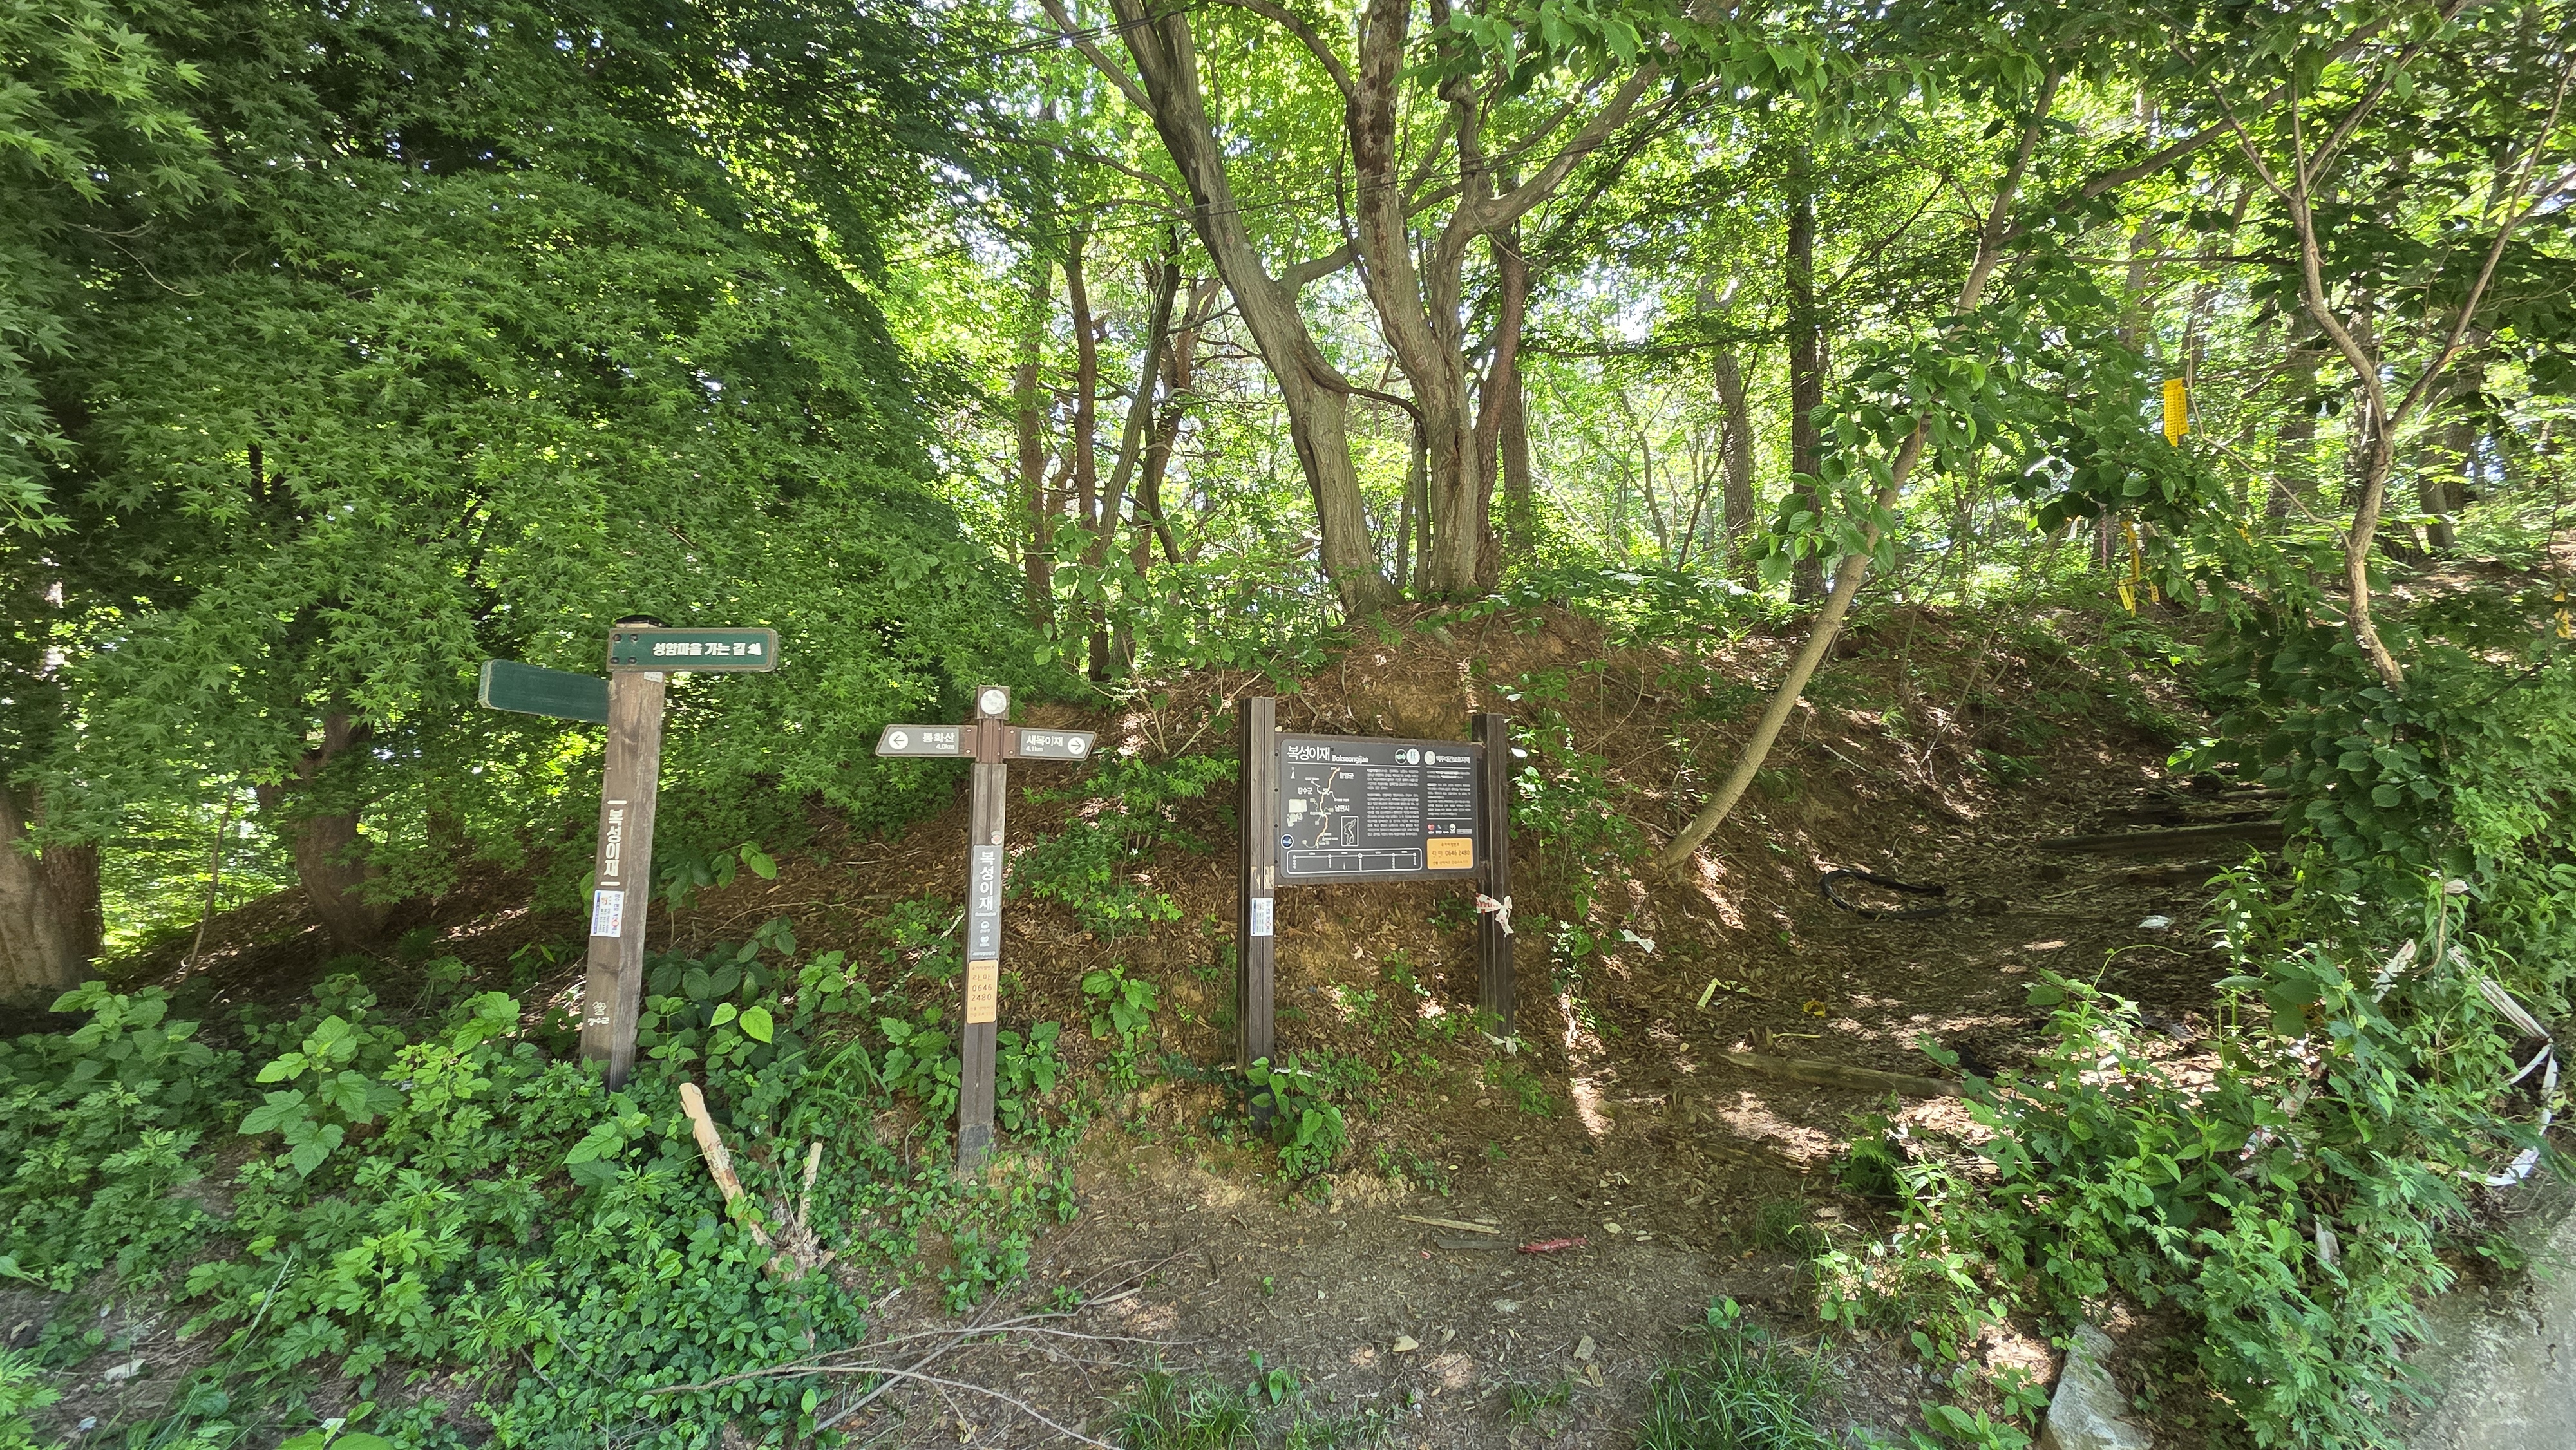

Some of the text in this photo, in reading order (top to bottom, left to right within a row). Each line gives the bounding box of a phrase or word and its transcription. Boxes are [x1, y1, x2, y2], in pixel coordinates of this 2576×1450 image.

[652, 643, 746, 656] 성암마을 가는 길
[922, 732, 955, 743] 봉화산
[1026, 735, 1063, 747] 새목이재
[1287, 745, 1331, 761] 복성이재
[1297, 787, 1313, 795] 장수군
[603, 809, 623, 877] 복성이재
[978, 851, 996, 911] 복성이재
[972, 983, 992, 992] 0646
[971, 993, 992, 1002] 2480
